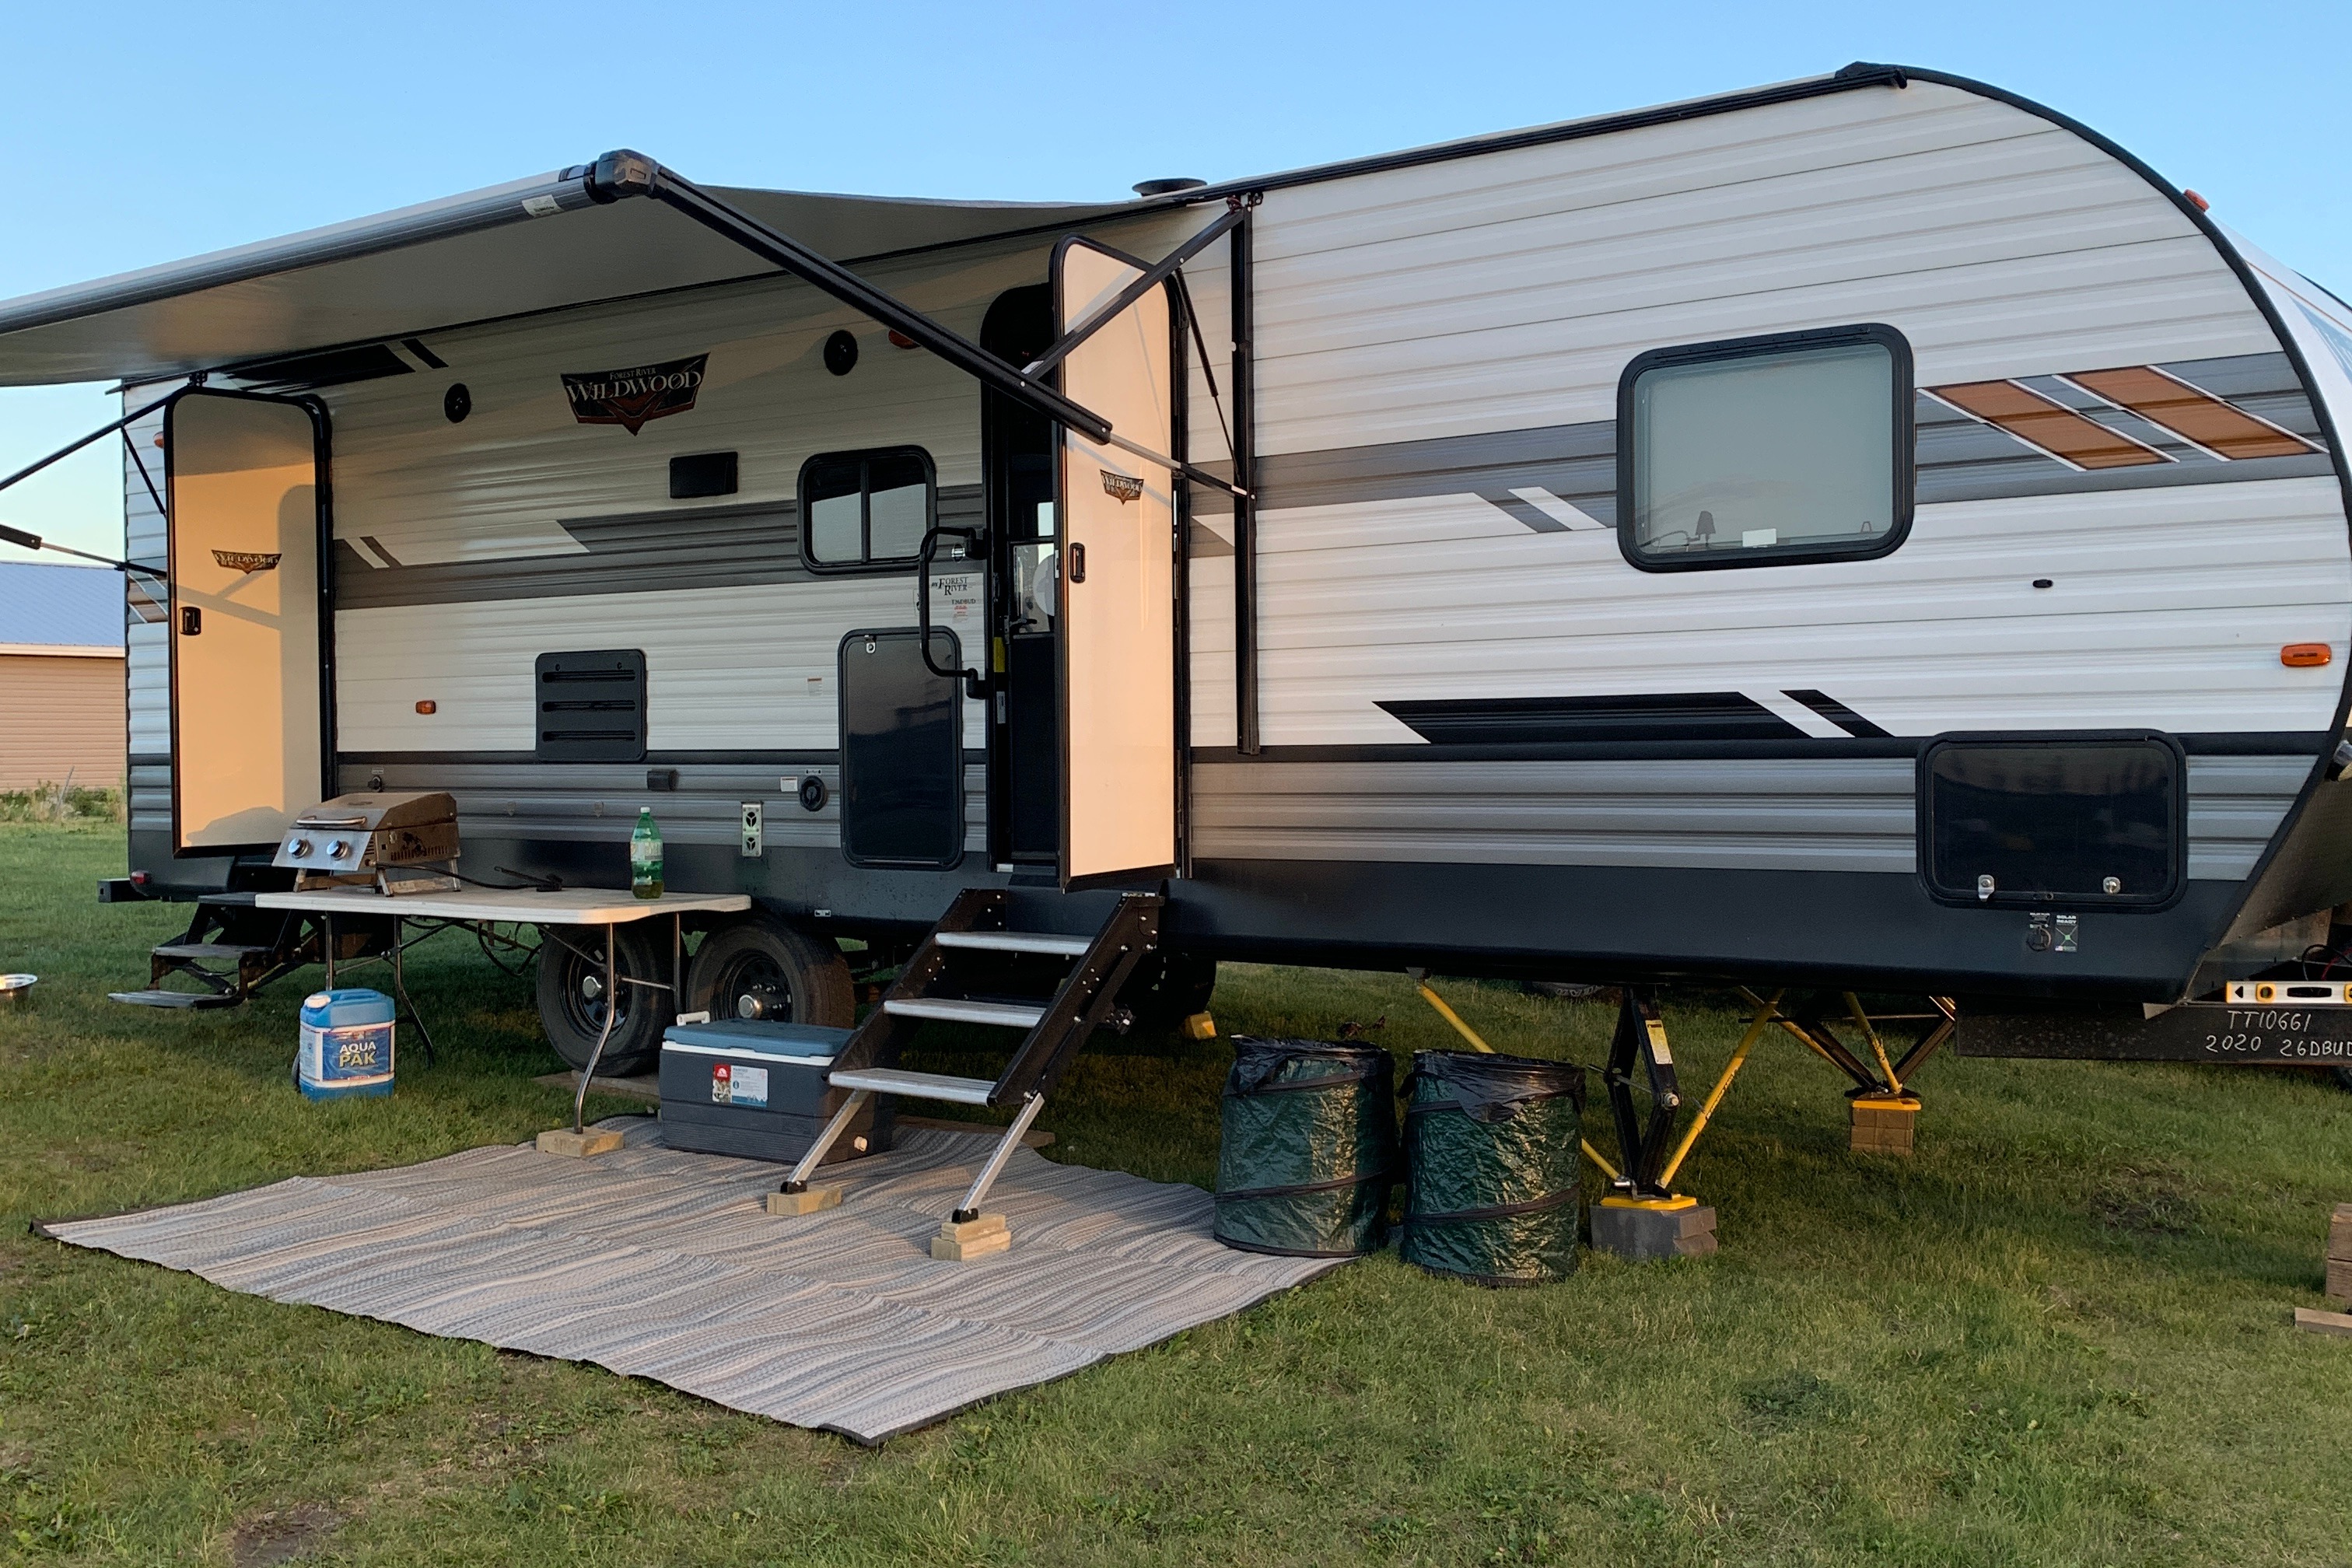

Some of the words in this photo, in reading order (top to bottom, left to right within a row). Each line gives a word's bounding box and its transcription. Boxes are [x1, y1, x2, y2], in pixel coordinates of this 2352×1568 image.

[610, 369, 635, 381] FOREST
[635, 367, 656, 377] RIVER
[566, 370, 702, 403] WILDWOOD
[939, 576, 968, 590] FOREST
[944, 584, 968, 596] RIVER
[2227, 1010, 2312, 1032] TT10661
[339, 1041, 376, 1055] AQUA
[2206, 1034, 2262, 1053] 2020
[339, 1051, 376, 1068] PAK
